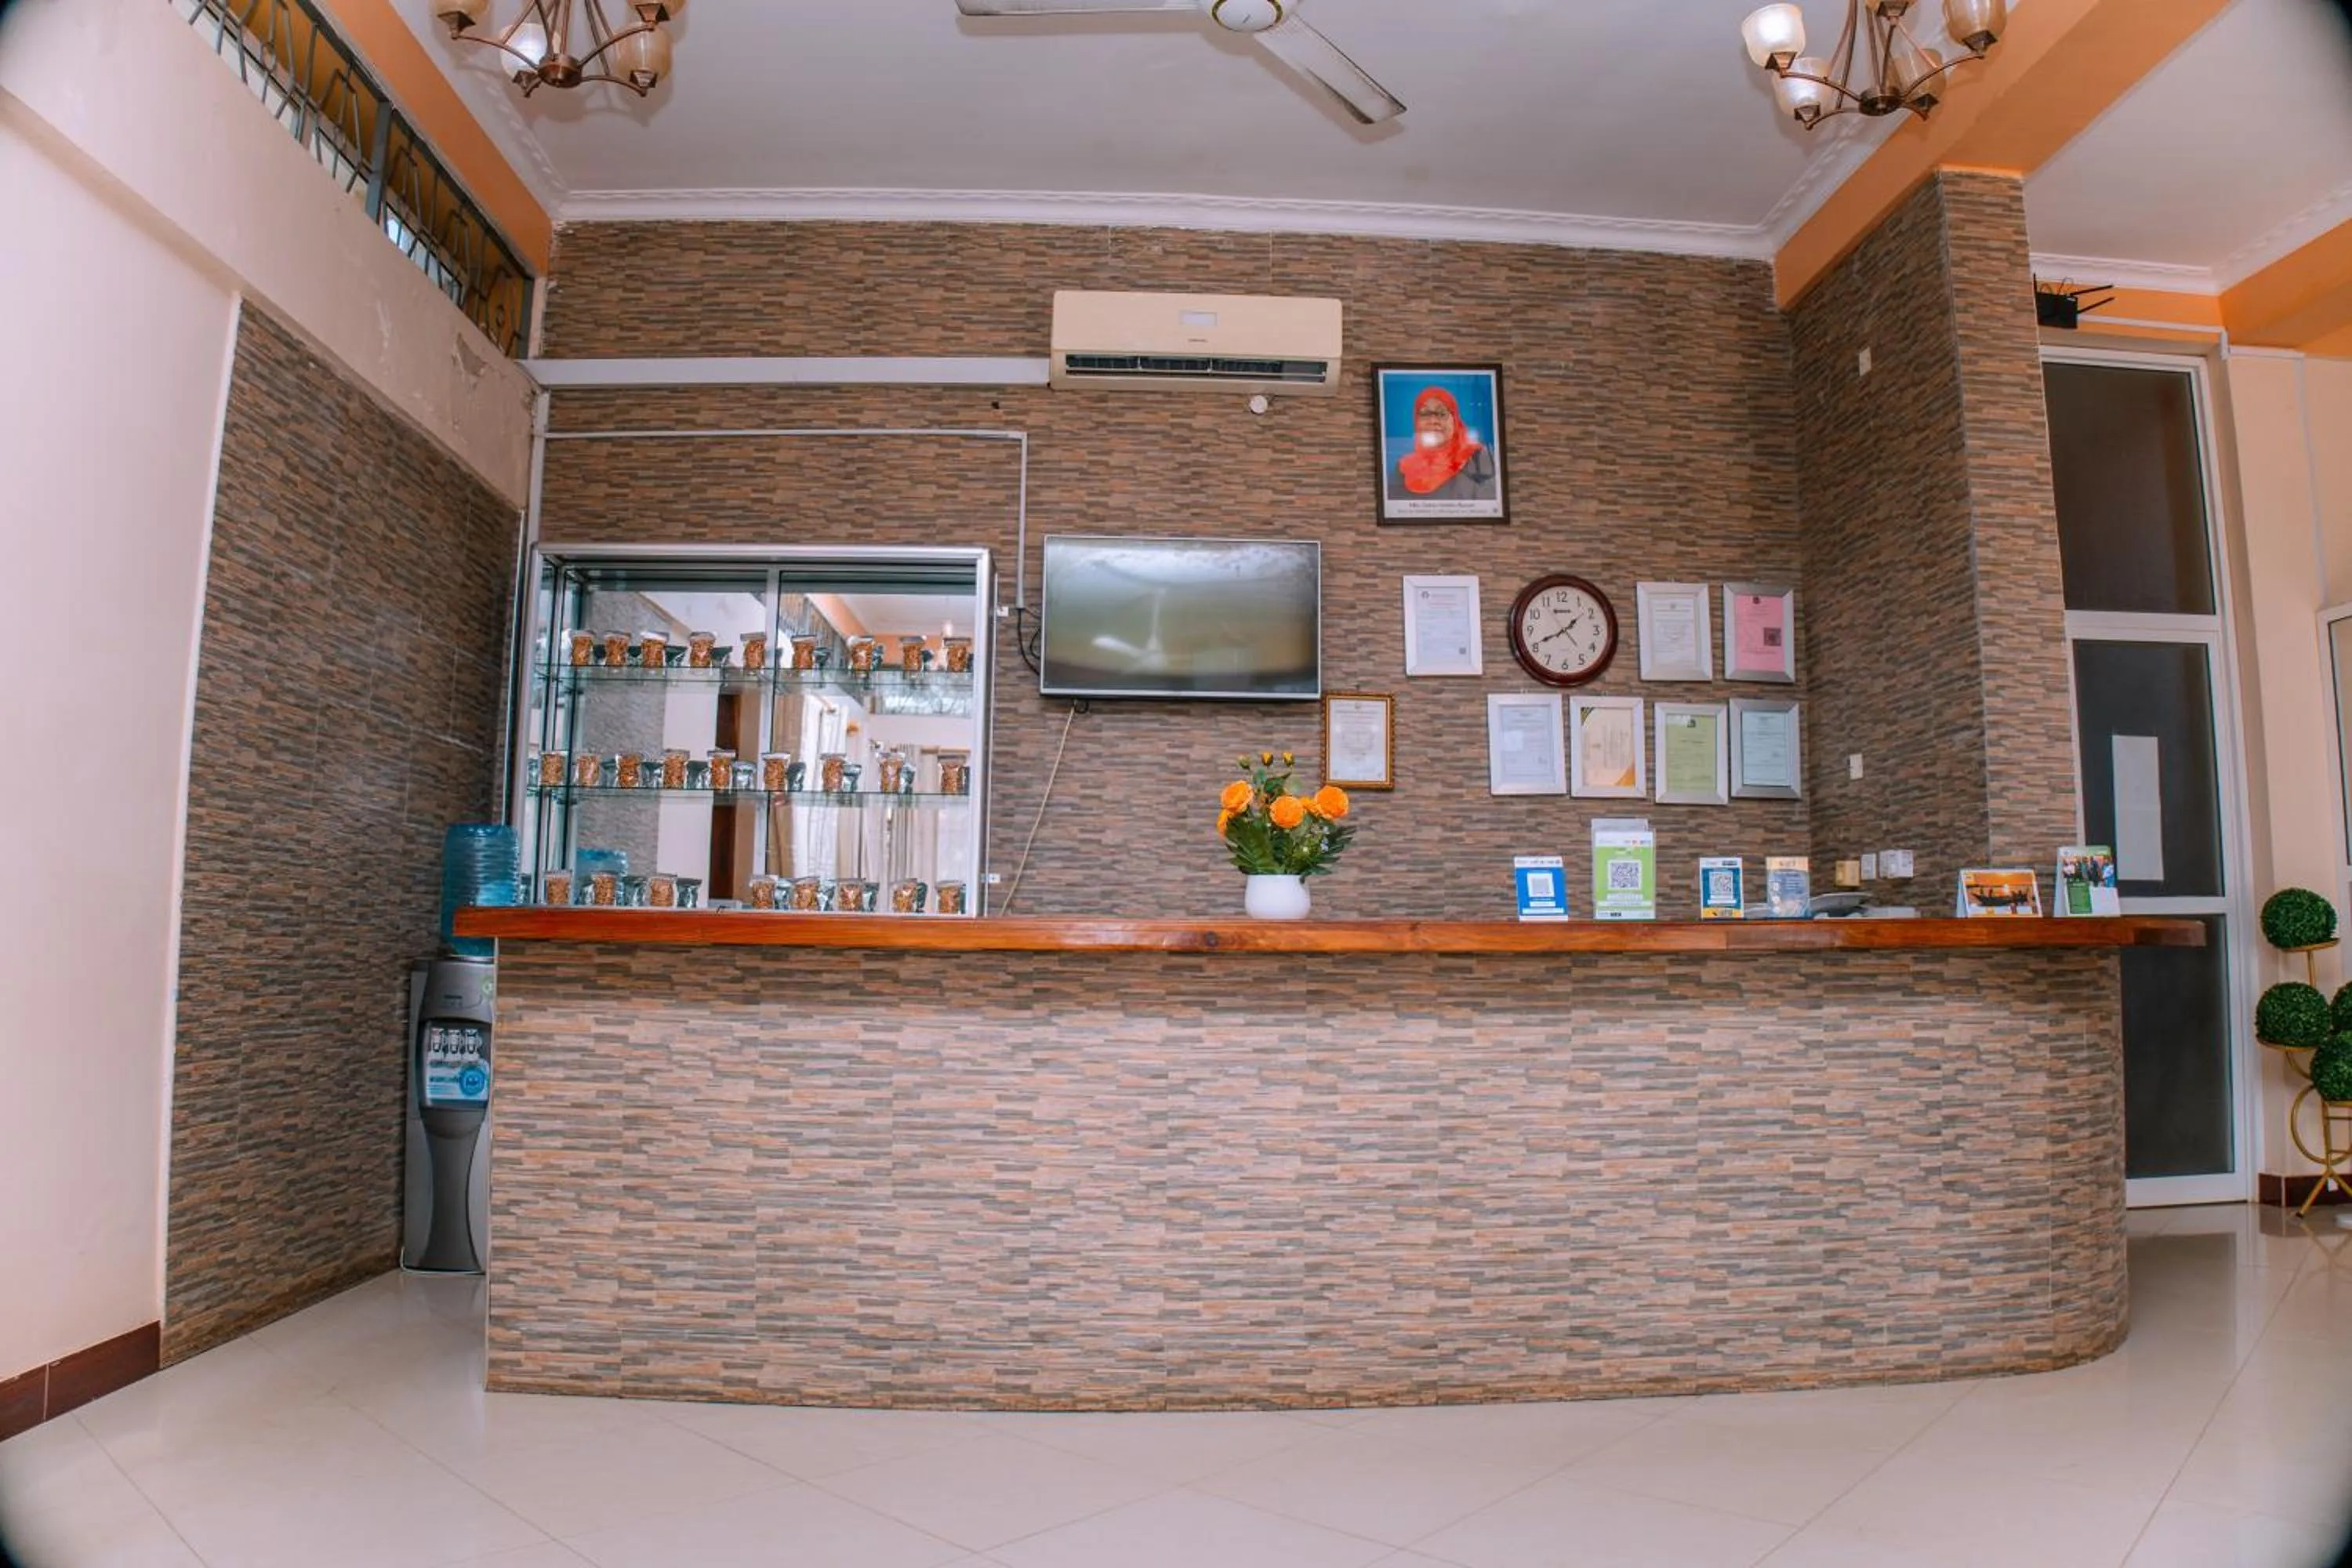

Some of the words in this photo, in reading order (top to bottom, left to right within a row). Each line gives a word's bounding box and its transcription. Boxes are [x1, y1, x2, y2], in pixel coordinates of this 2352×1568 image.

[1542, 596, 1551, 607] 11
[1555, 590, 1568, 603] 12
[1577, 595, 1581, 608] 1
[1530, 608, 1541, 620] 10
[1588, 608, 1595, 619] 2
[1526, 626, 1534, 637] 9
[1592, 625, 1600, 636] 3
[1531, 642, 1539, 653] 8
[1588, 642, 1596, 652] 4
[1544, 654, 1552, 665] 7
[1561, 659, 1569, 670] 6
[1578, 653, 1585, 665] 5
